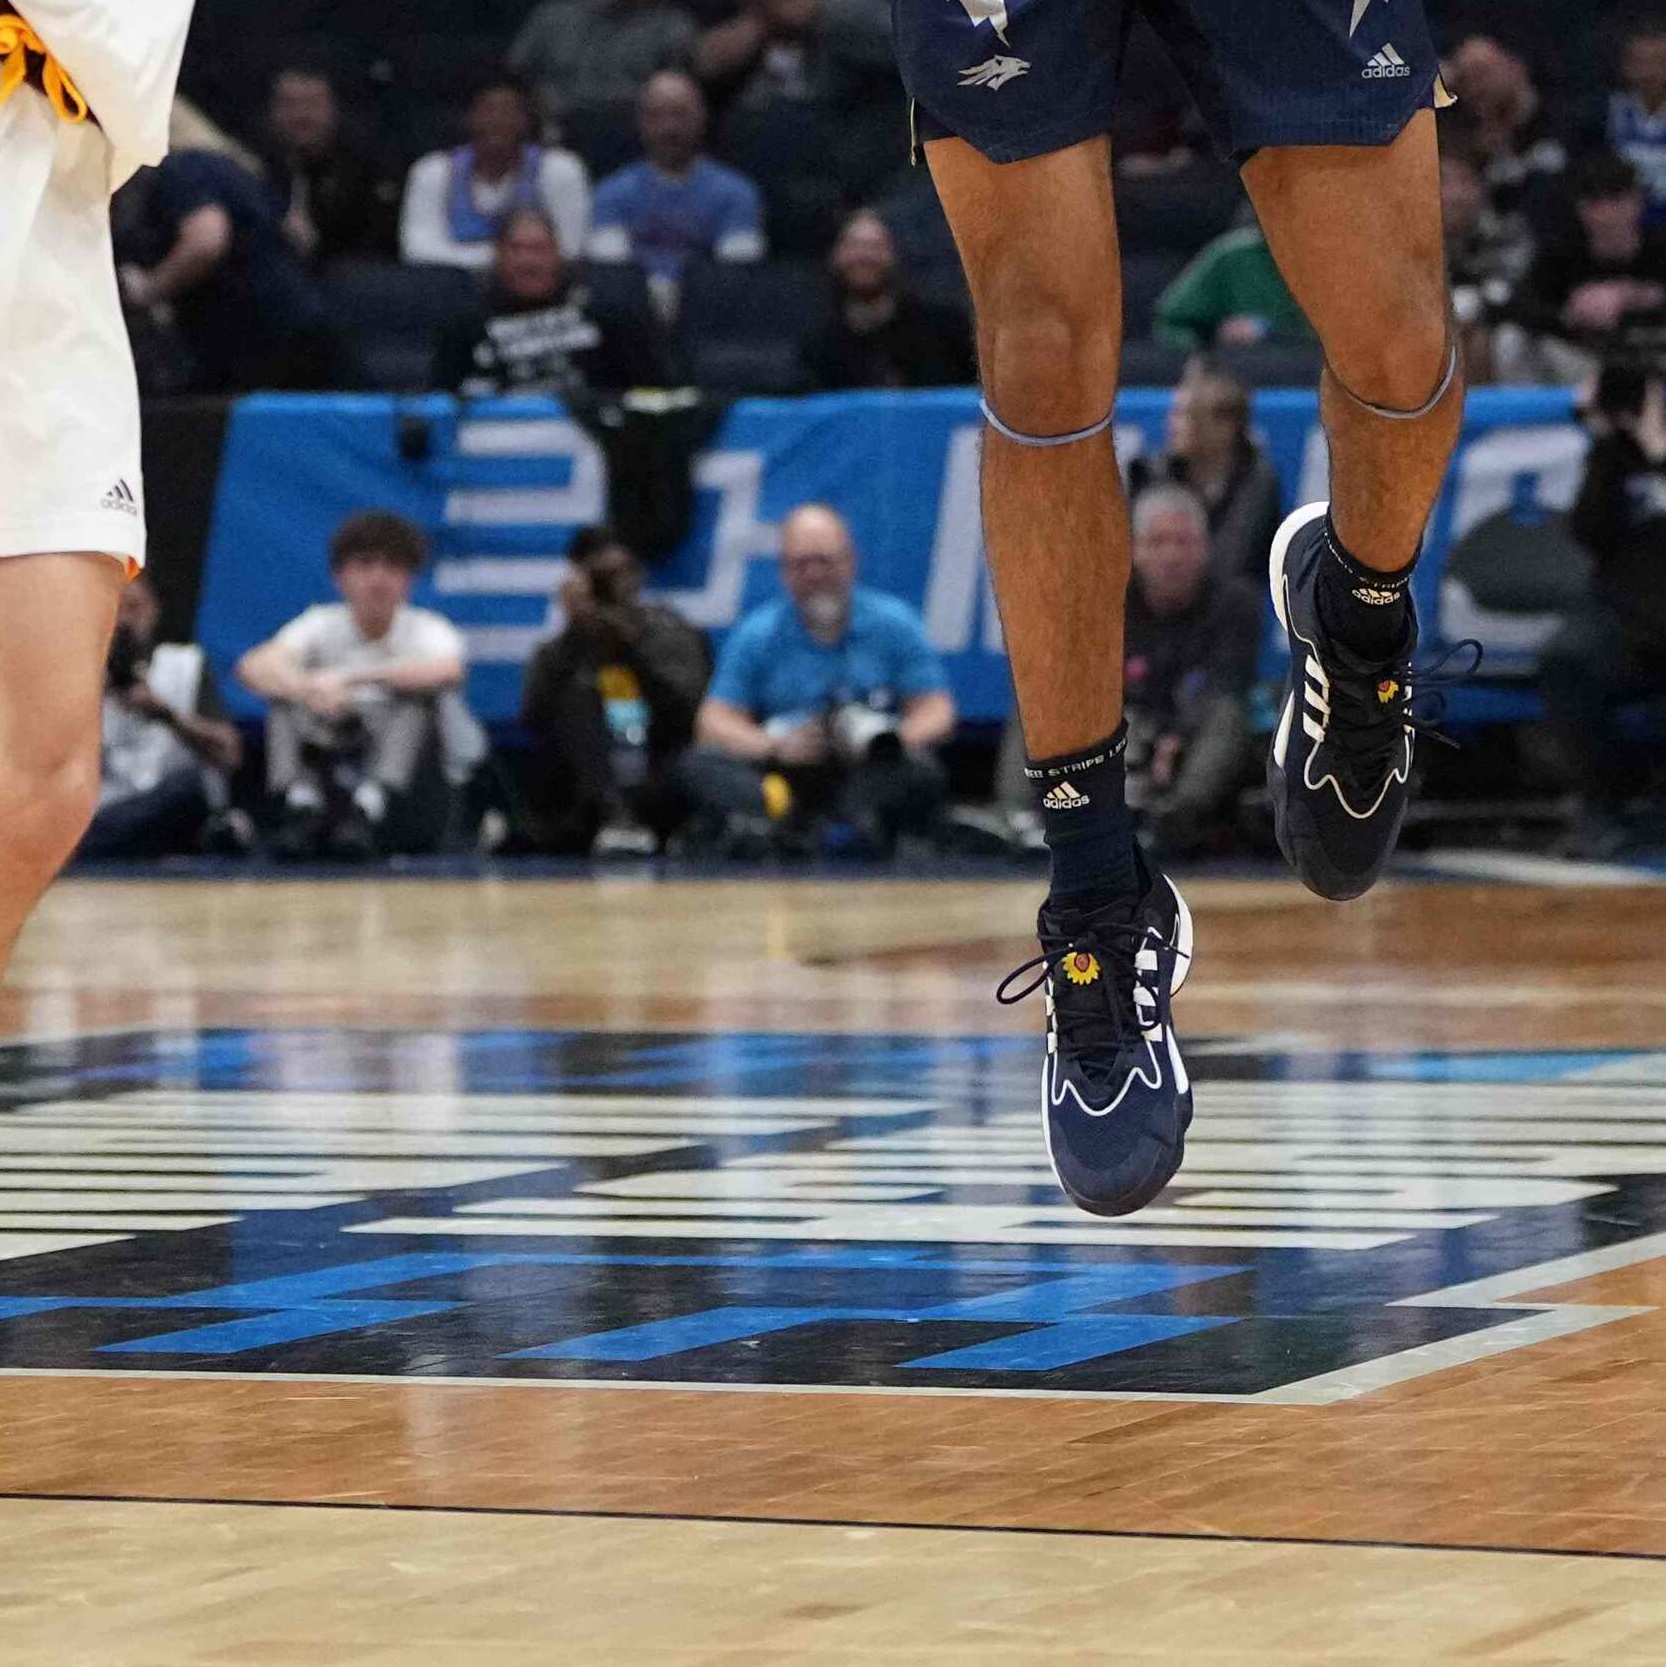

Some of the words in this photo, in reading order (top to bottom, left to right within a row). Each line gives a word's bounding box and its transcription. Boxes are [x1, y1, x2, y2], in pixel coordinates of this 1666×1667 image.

[1361, 64, 1411, 79] adidas
[1047, 754, 1105, 777] STRIPE
[1042, 794, 1091, 810] adidas
